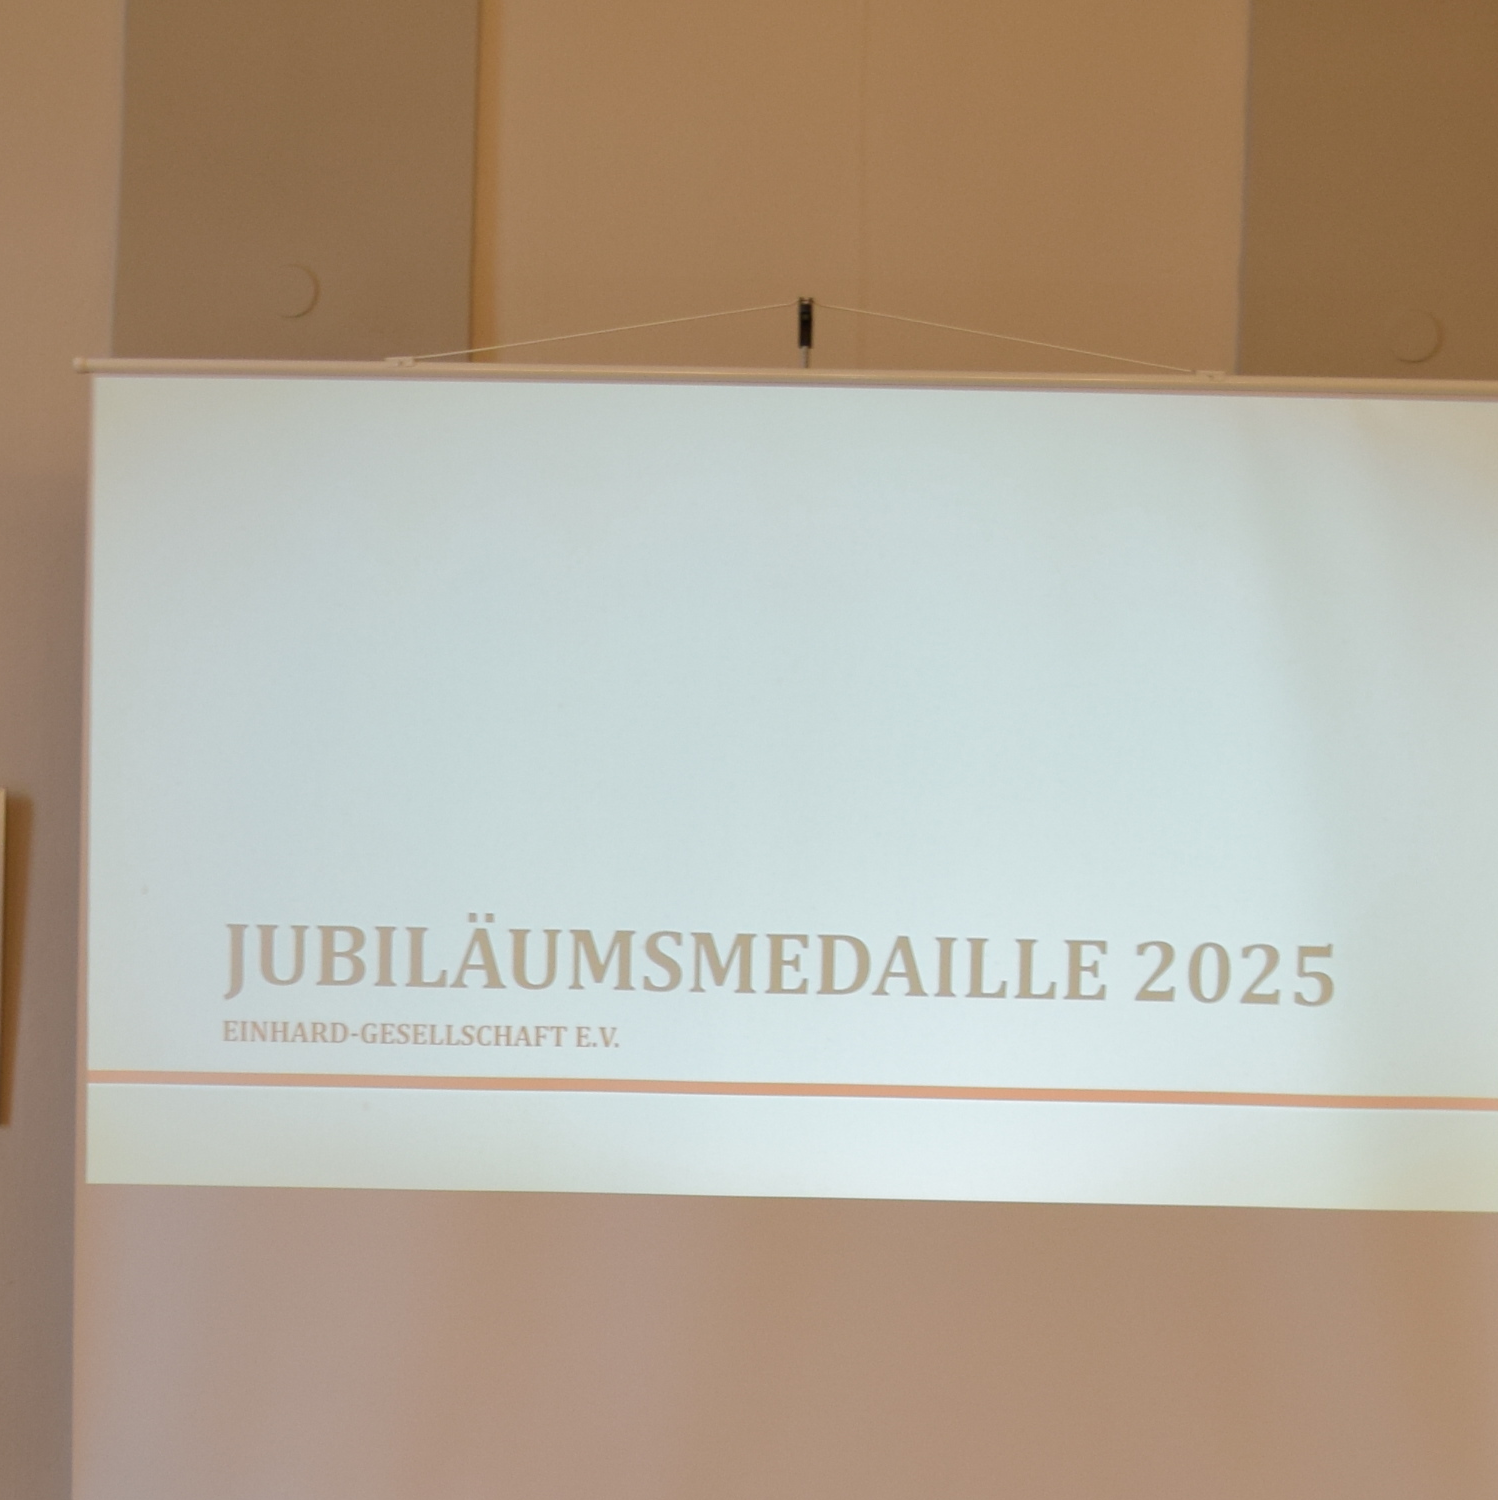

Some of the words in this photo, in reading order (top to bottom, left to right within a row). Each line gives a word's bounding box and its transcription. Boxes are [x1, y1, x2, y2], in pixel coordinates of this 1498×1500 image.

[222, 911, 1109, 1001] JUBILÄUMSMEDAILLE
[1135, 940, 1337, 1007] 2025
[221, 1018, 568, 1047] EINHARD-GESELLSCHAFT
[574, 1025, 622, 1049] E.V.
